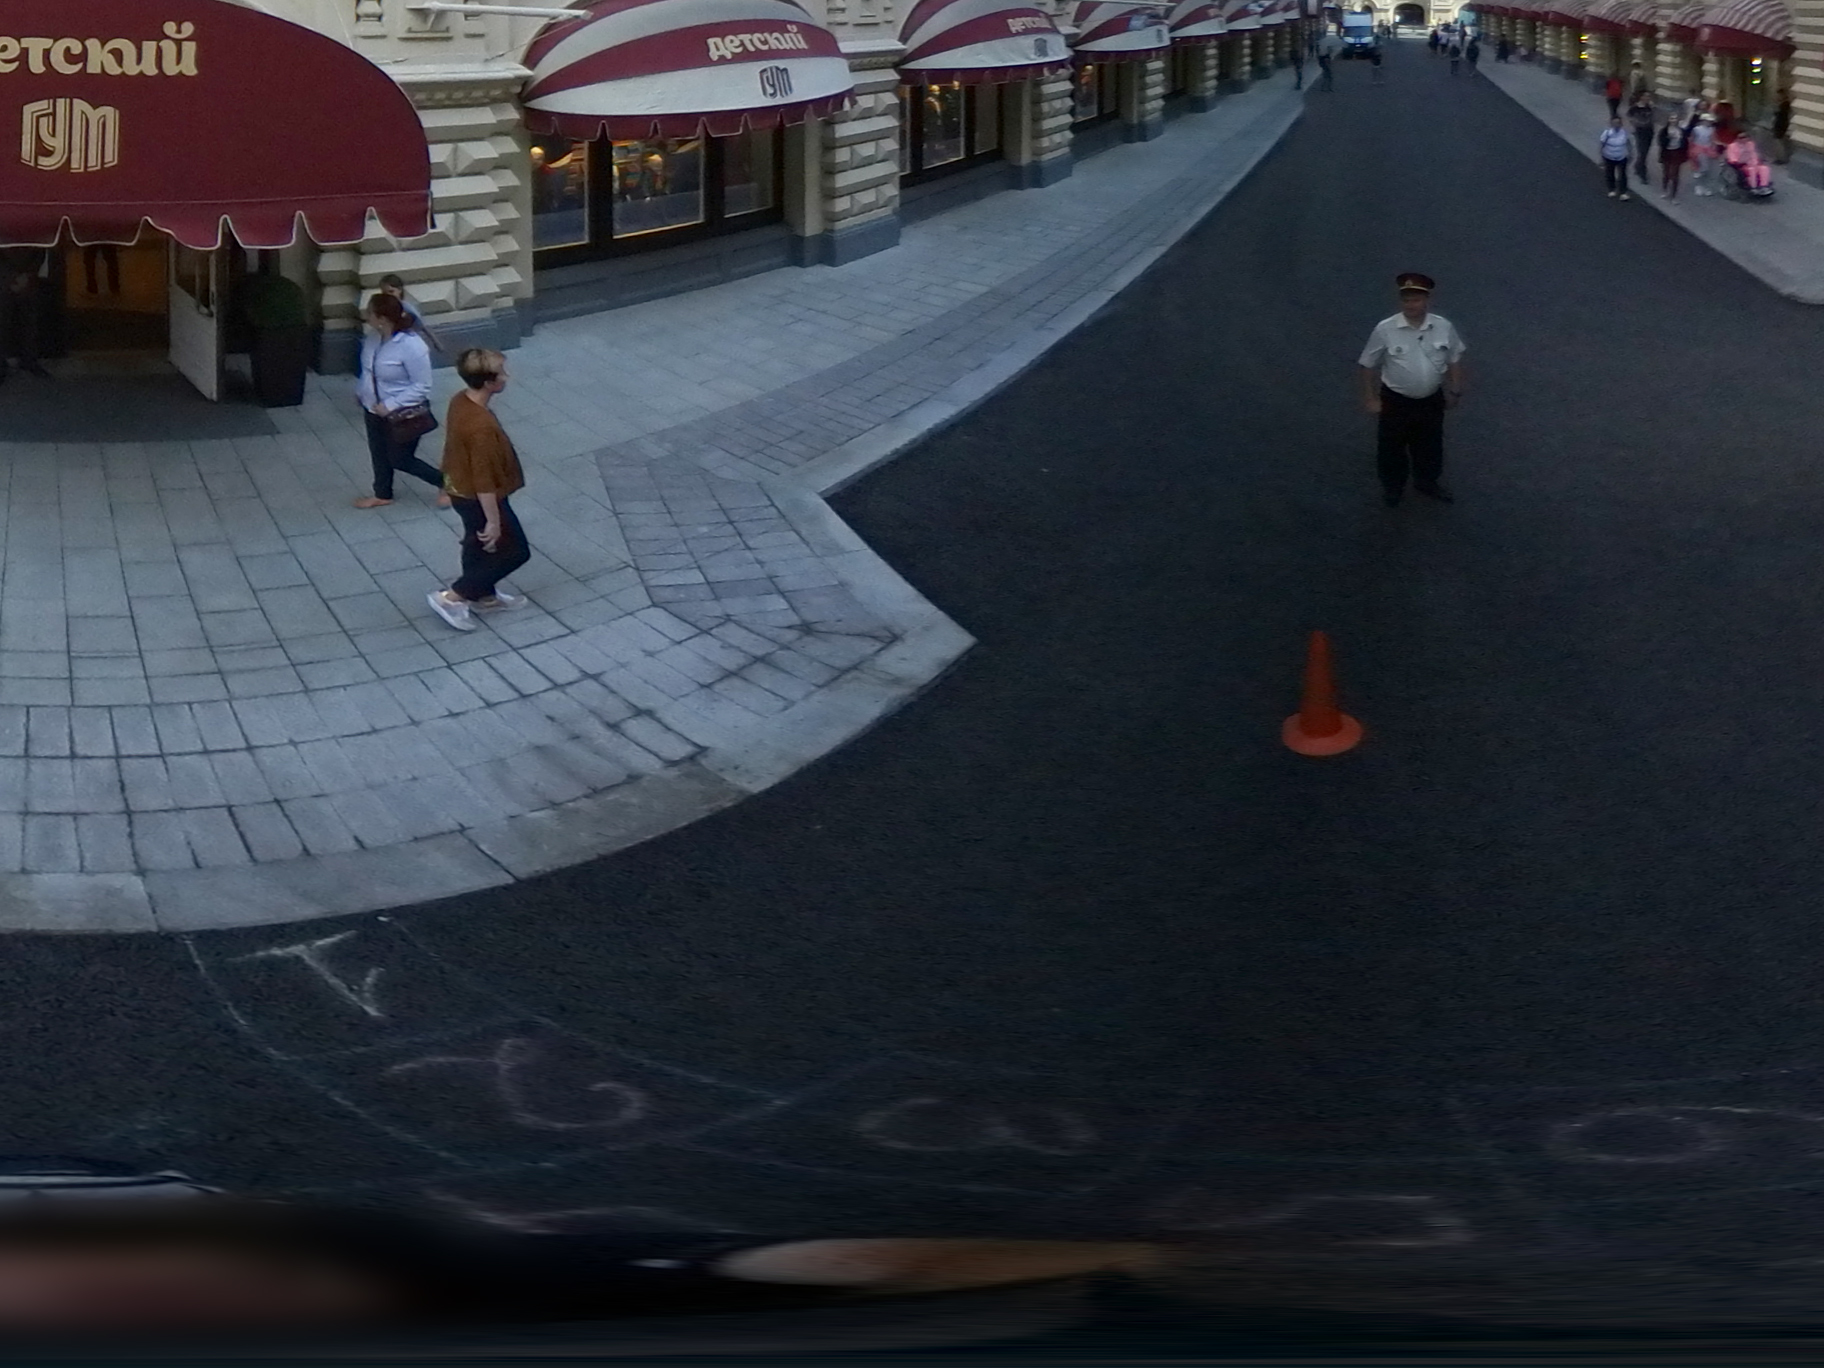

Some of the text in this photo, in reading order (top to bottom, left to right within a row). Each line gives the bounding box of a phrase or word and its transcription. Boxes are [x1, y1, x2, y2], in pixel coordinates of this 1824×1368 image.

[706, 24, 809, 62] детский
[759, 66, 794, 99] ГУМ
[20, 97, 119, 172] ГУМ
